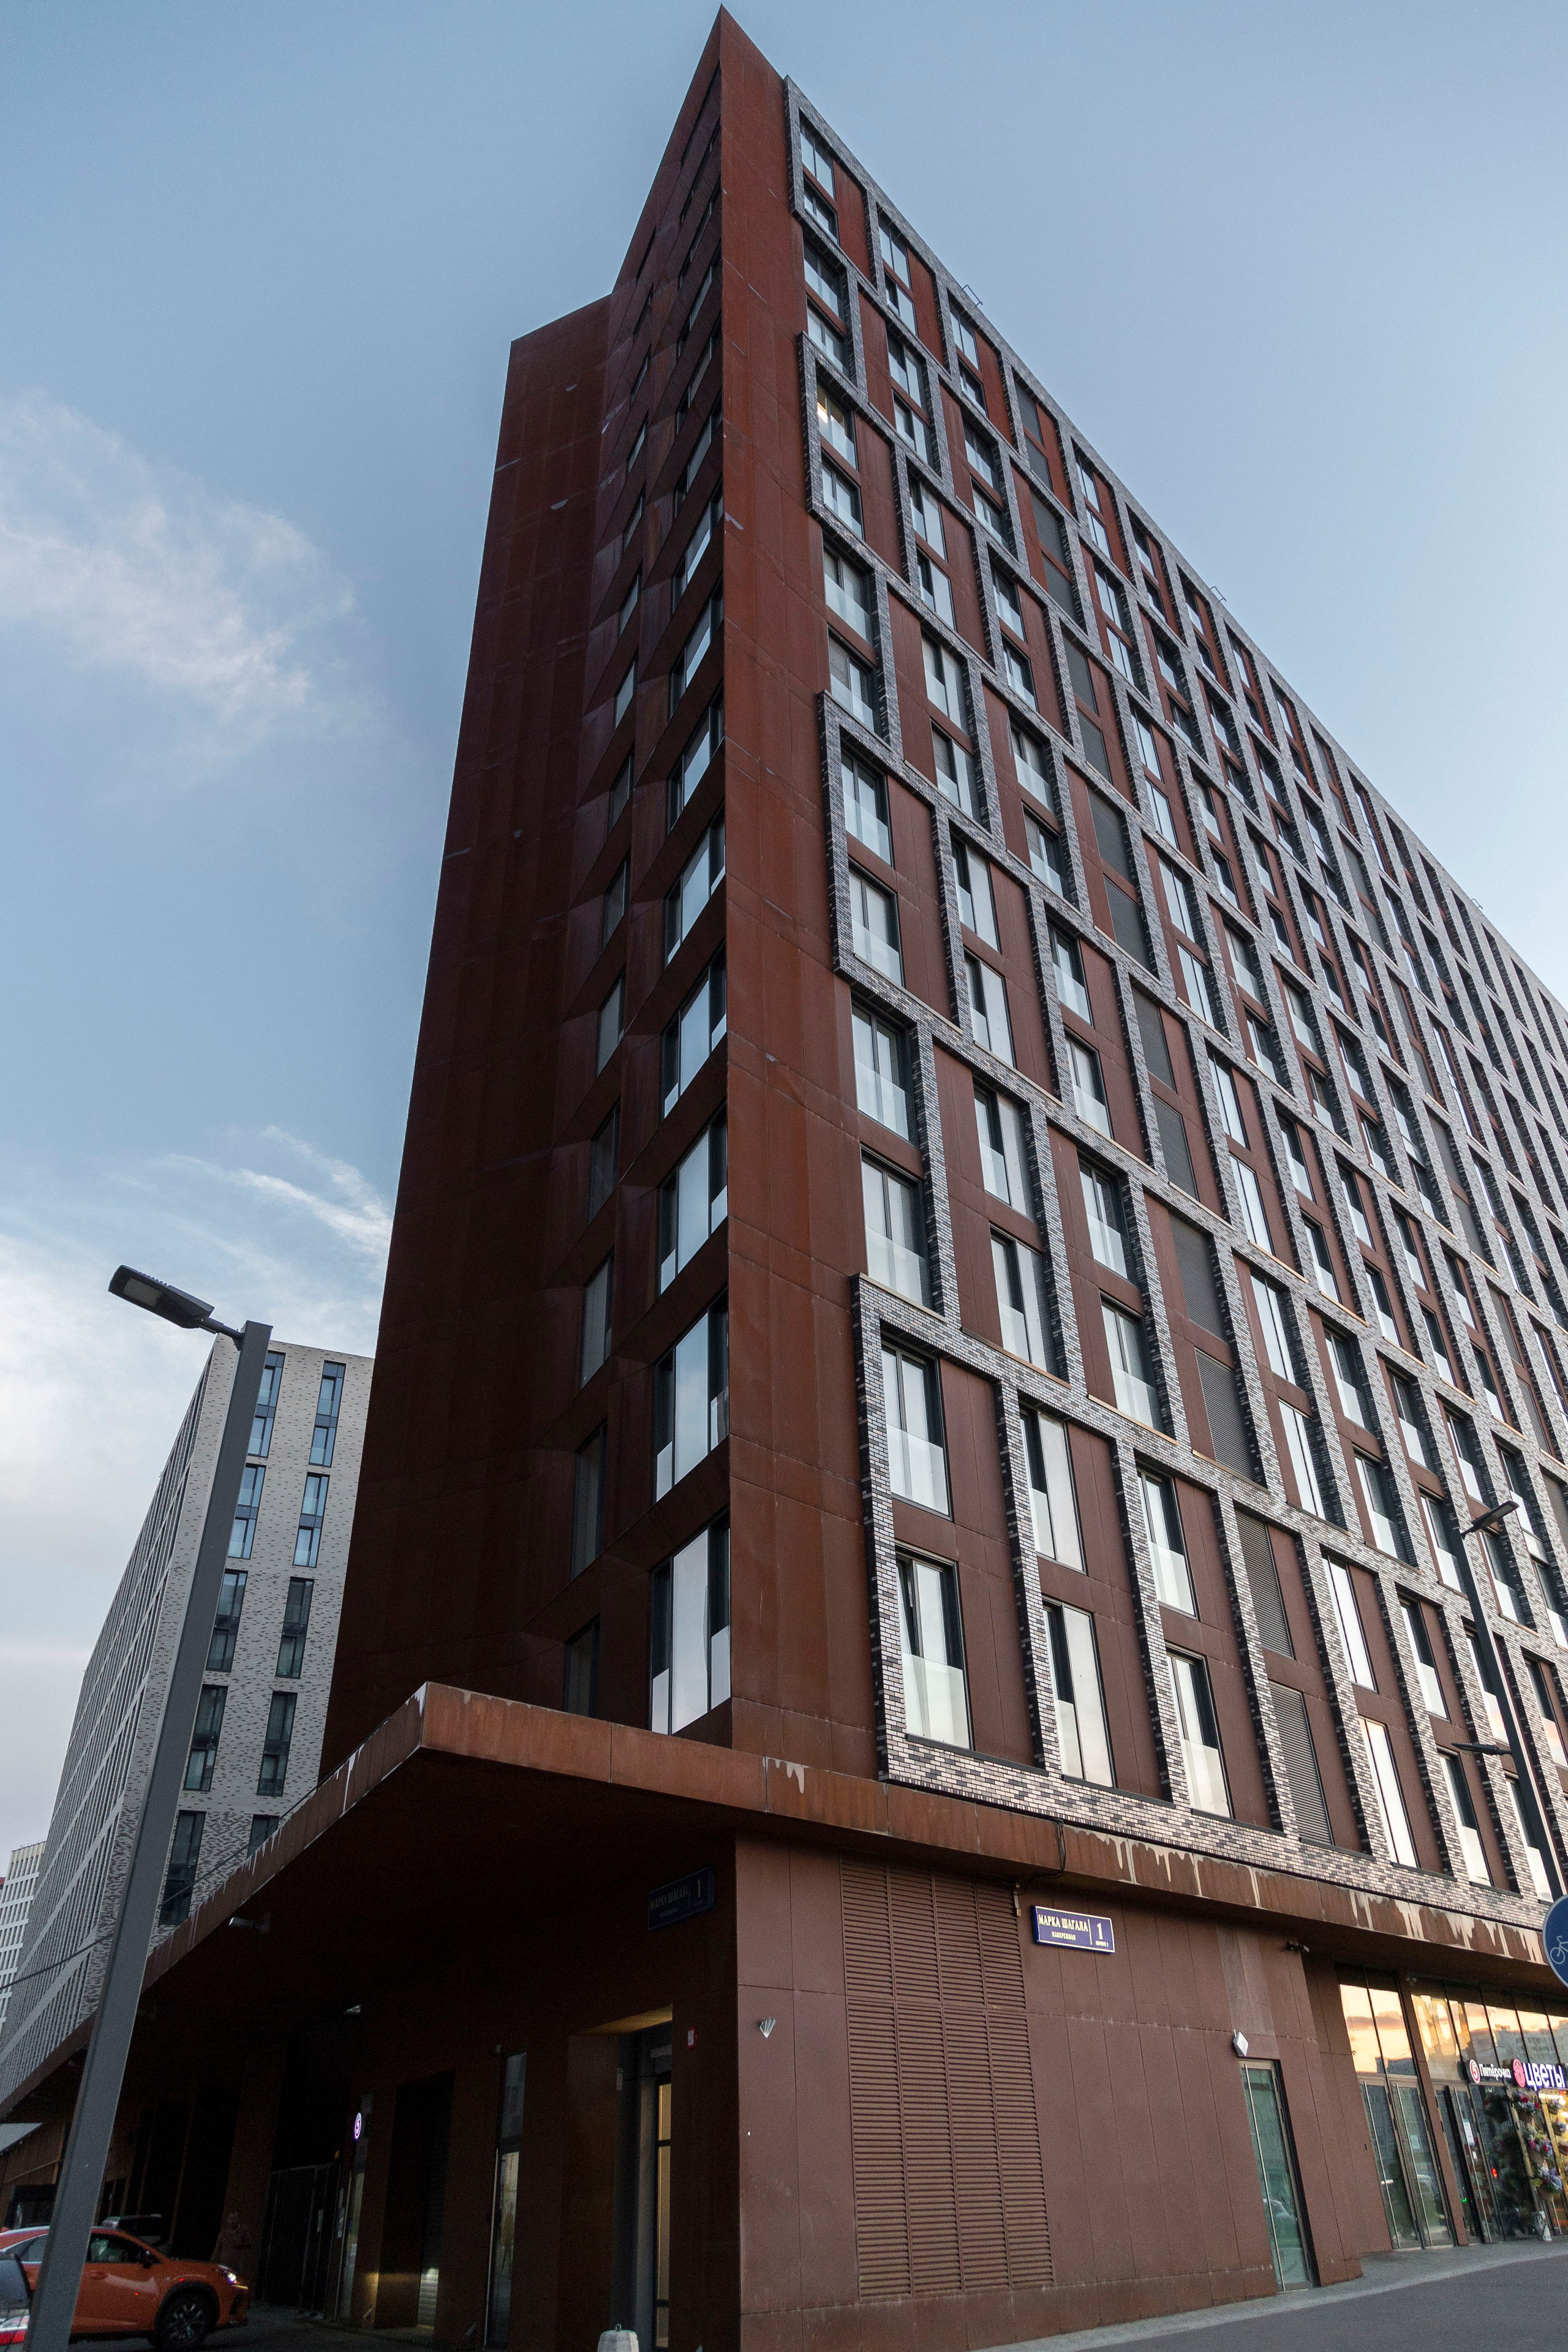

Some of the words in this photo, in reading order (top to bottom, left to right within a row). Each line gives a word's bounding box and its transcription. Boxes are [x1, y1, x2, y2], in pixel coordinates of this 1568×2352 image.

[697, 1879, 701, 1898] 1
[1038, 1914, 1061, 1928] МАРКА
[1061, 1918, 1089, 1932] ШАГАЛА
[1096, 1923, 1103, 1940] 1
[1479, 2064, 1512, 2081] Пятёрочка
